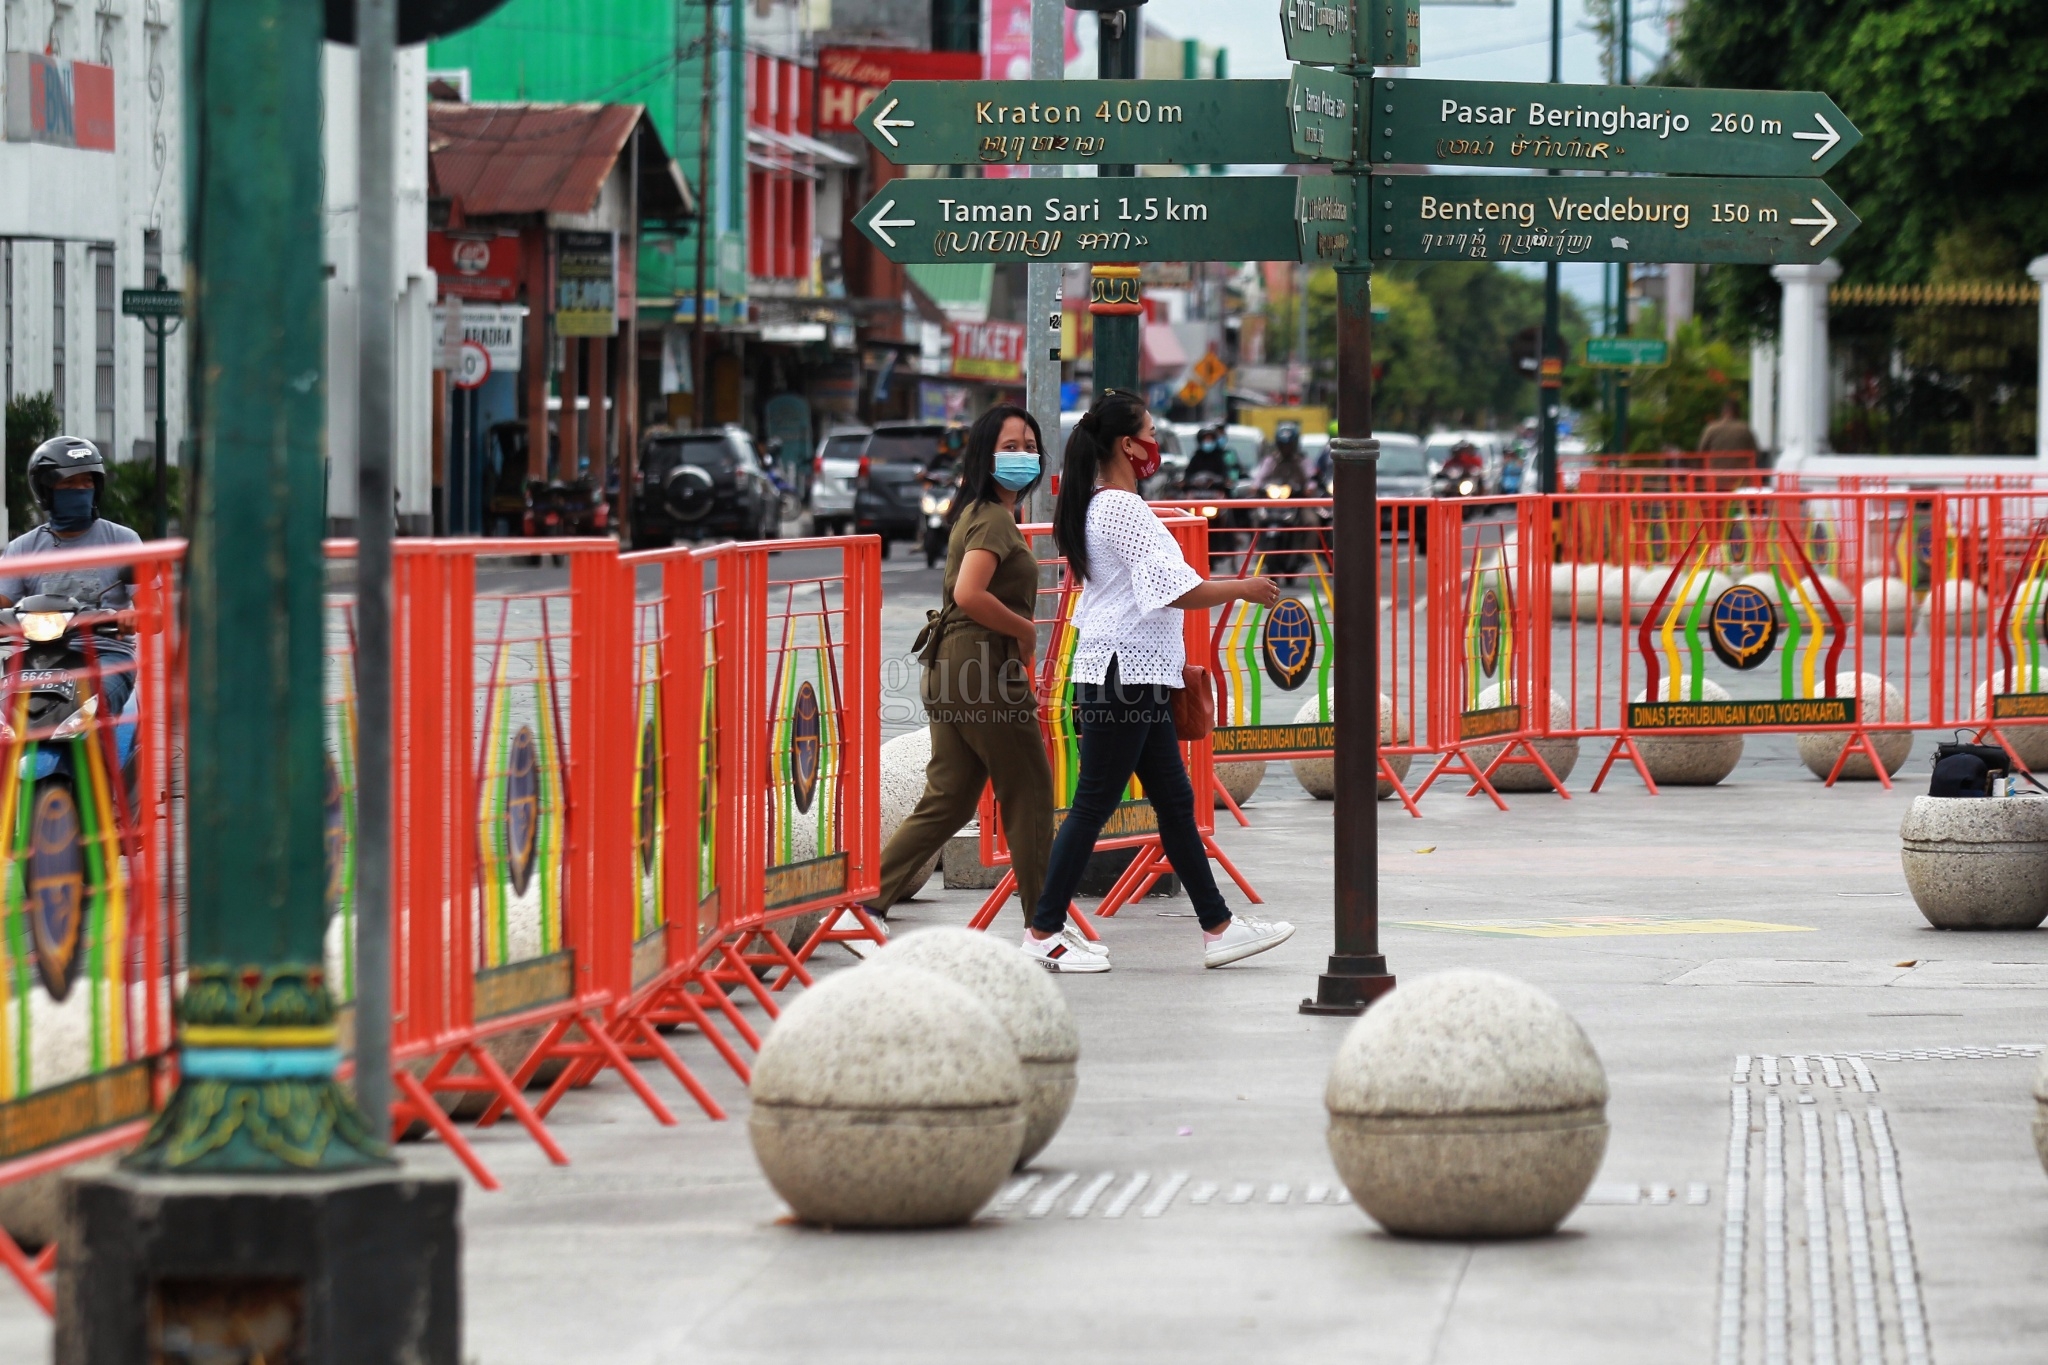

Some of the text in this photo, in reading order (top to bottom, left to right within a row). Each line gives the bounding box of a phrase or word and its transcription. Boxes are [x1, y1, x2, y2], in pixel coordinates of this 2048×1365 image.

[975, 101, 1082, 125] Kraton
[1440, 99, 1516, 126] Pasar
[1528, 101, 1691, 139] Beringharjo
[1710, 113, 1755, 134] 260
[938, 198, 1033, 223] Taman
[1045, 197, 1101, 223] Sari
[1420, 195, 1779, 230] Benteng Vredeburg 150 m
[957, 324, 1023, 362] TIKET
[1635, 701, 1847, 727] DINAS PERHUBUNGAN KOTA YOGYAKARTA
[1212, 730, 1235, 752] DINAS
[1236, 728, 1295, 751] PERHUBUNGAN
[1296, 727, 1317, 748] KOTA
